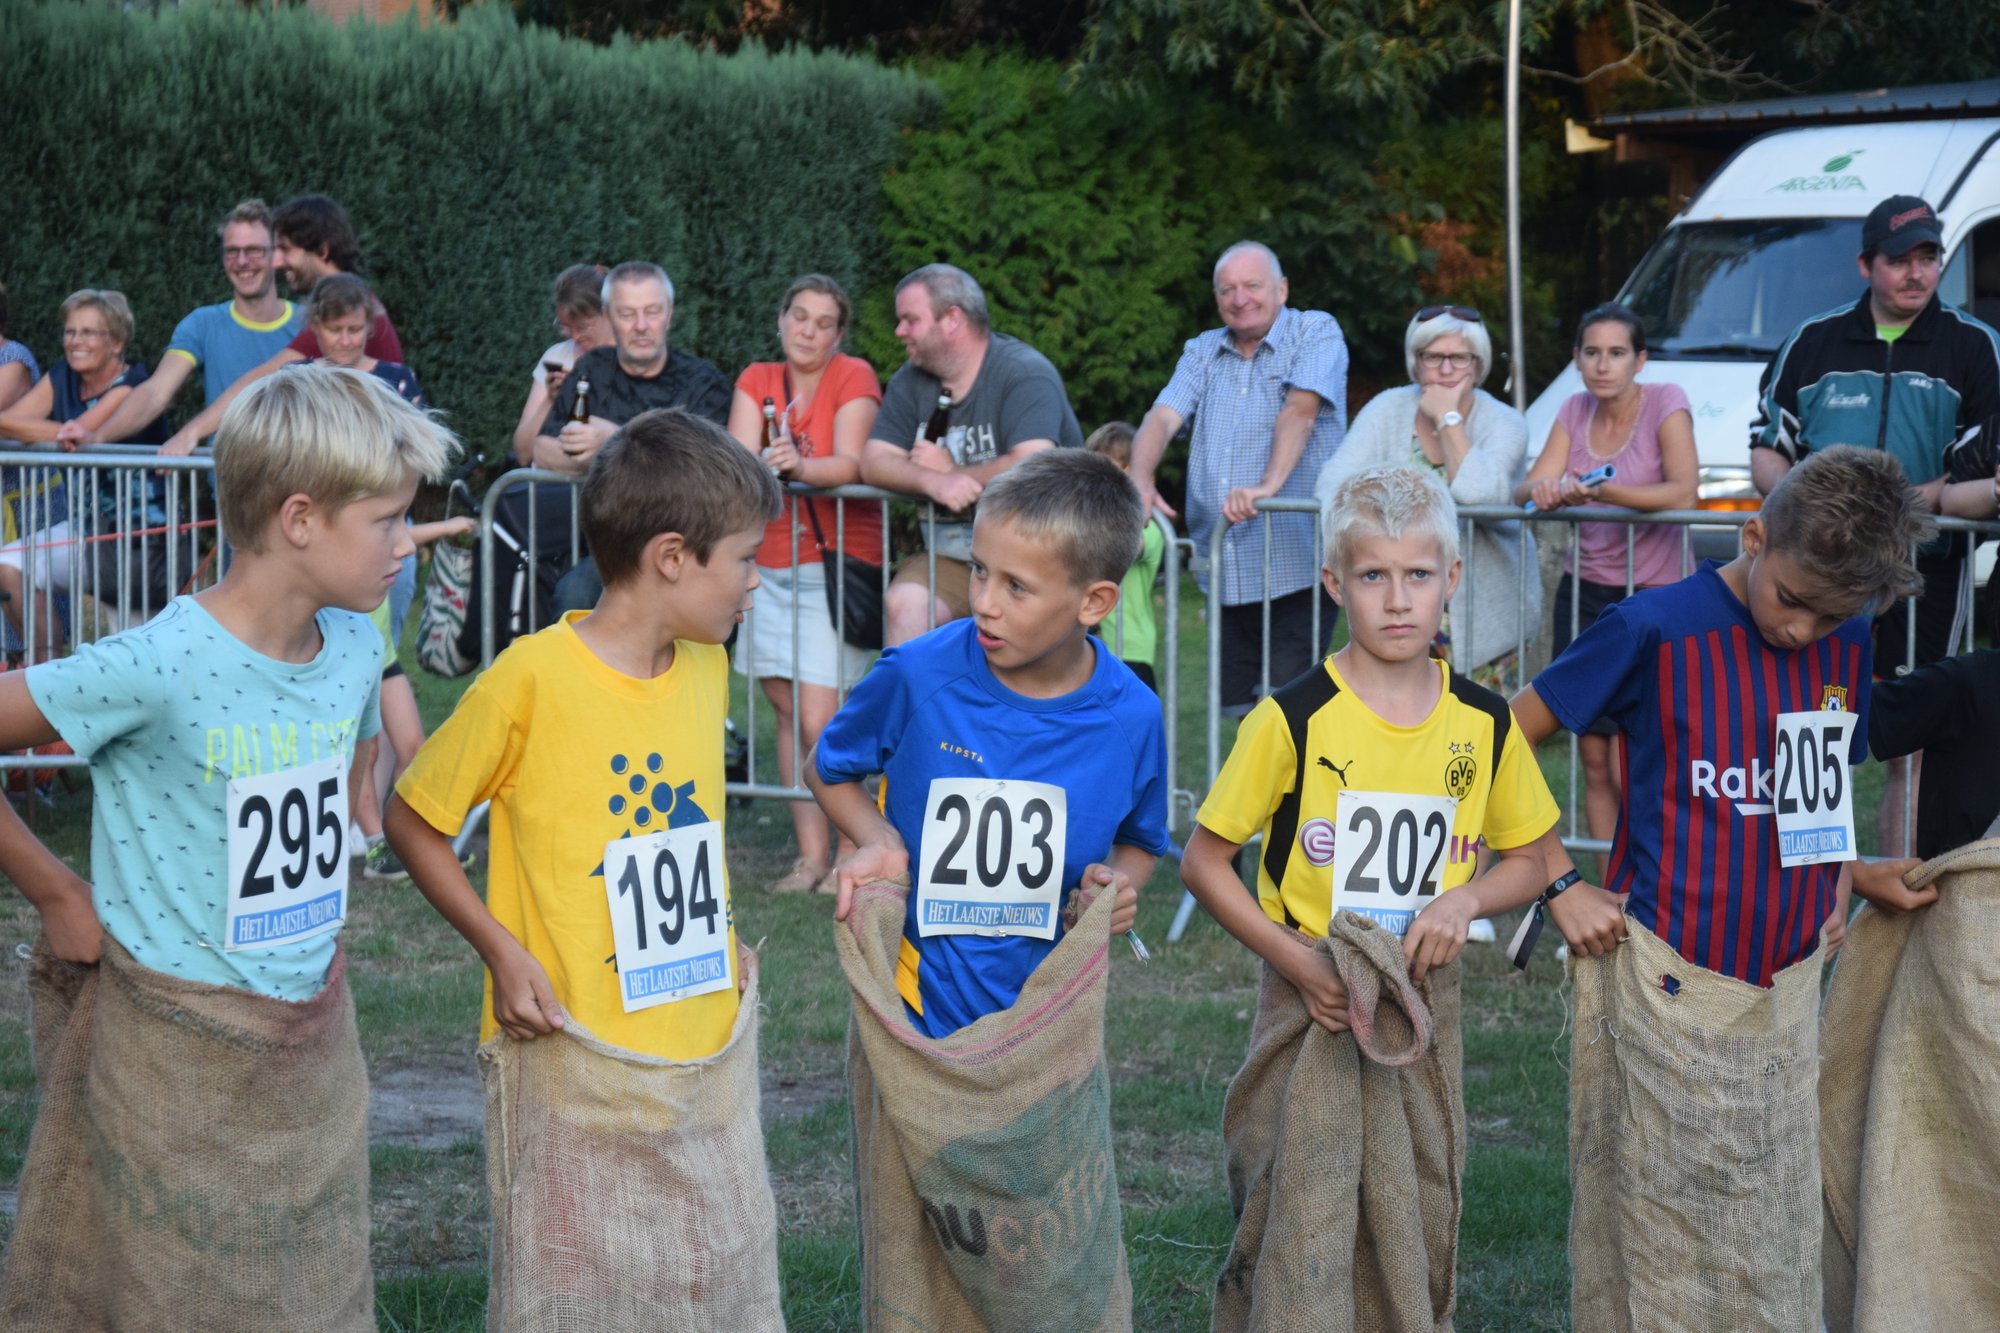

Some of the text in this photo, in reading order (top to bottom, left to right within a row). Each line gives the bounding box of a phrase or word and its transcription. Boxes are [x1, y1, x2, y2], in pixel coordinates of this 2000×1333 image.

[1767, 176, 1867, 192] ARGENTA
[205, 723, 299, 784] PALM
[940, 741, 984, 763] KIPSTA
[1450, 760, 1474, 787] BVB
[1777, 726, 1844, 815] 205
[238, 776, 342, 899] 295
[930, 794, 1053, 889] 203
[1344, 806, 1447, 896] 202
[1791, 832, 1819, 854] LAATSTE
[1819, 830, 1843, 851] NIEUWS
[617, 839, 718, 951] 194
[928, 902, 1044, 926] HET LAATSTE NIEUWS
[238, 897, 337, 942] HET LAATSTE NIEUWS
[1366, 910, 1408, 934] AATSTE
[630, 956, 721, 997] HET LAATSTE NIEUWS
